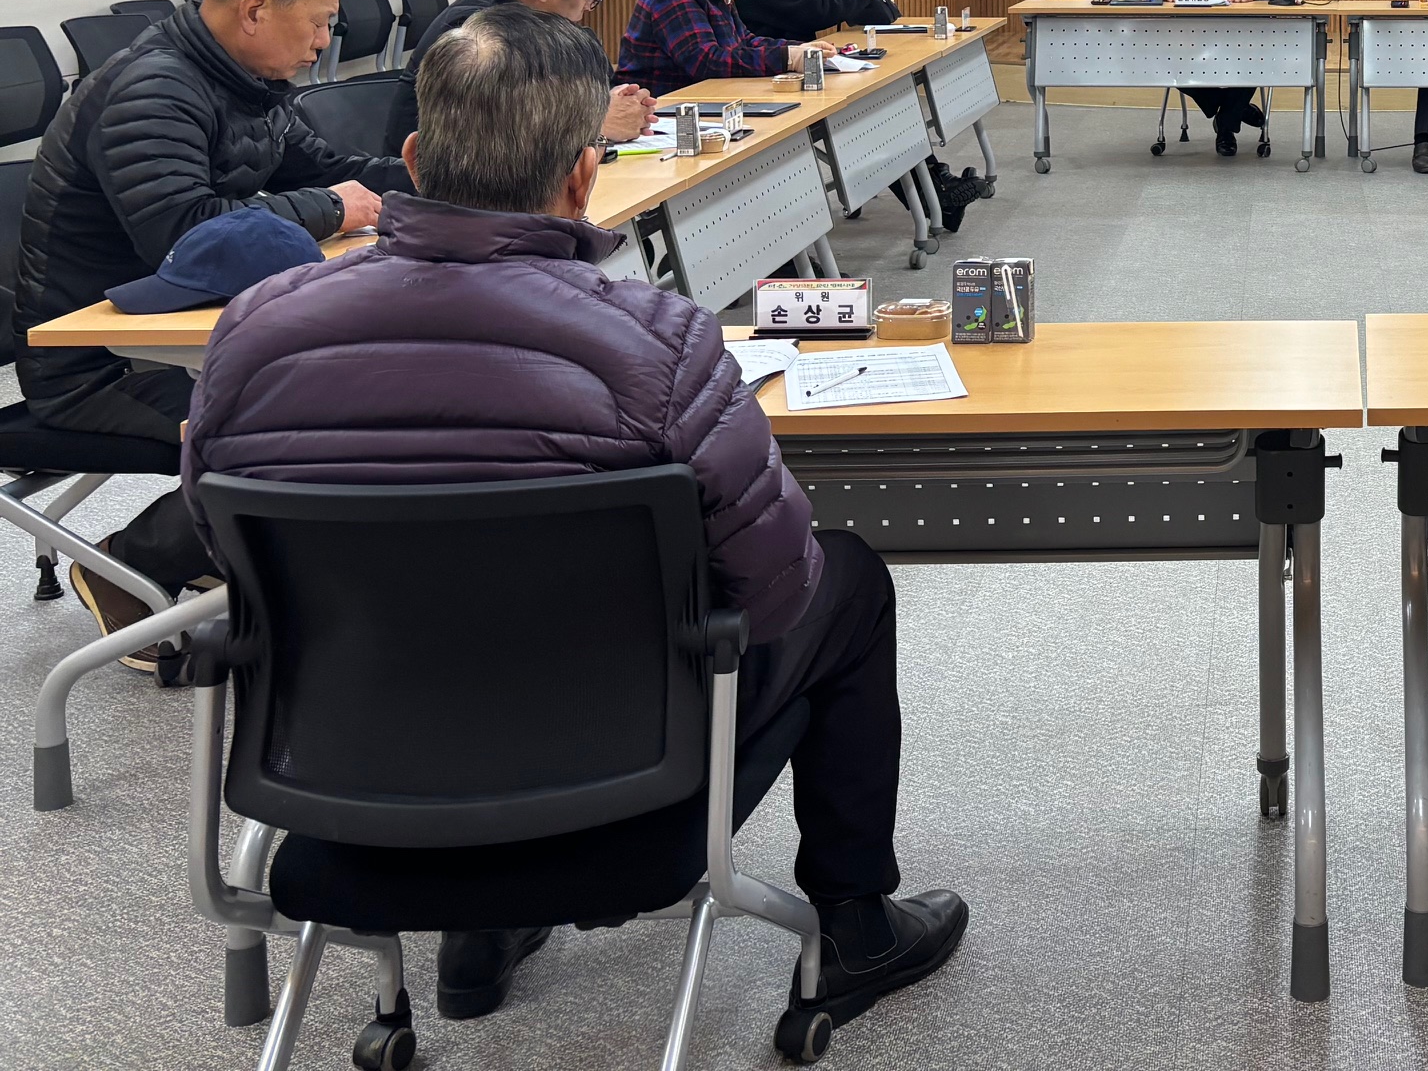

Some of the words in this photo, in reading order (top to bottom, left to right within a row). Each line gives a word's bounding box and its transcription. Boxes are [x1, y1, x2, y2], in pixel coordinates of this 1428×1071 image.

[956, 268, 987, 276] erom
[993, 267, 1024, 276] em
[794, 291, 830, 303] 위원
[771, 304, 855, 324] 손상균
